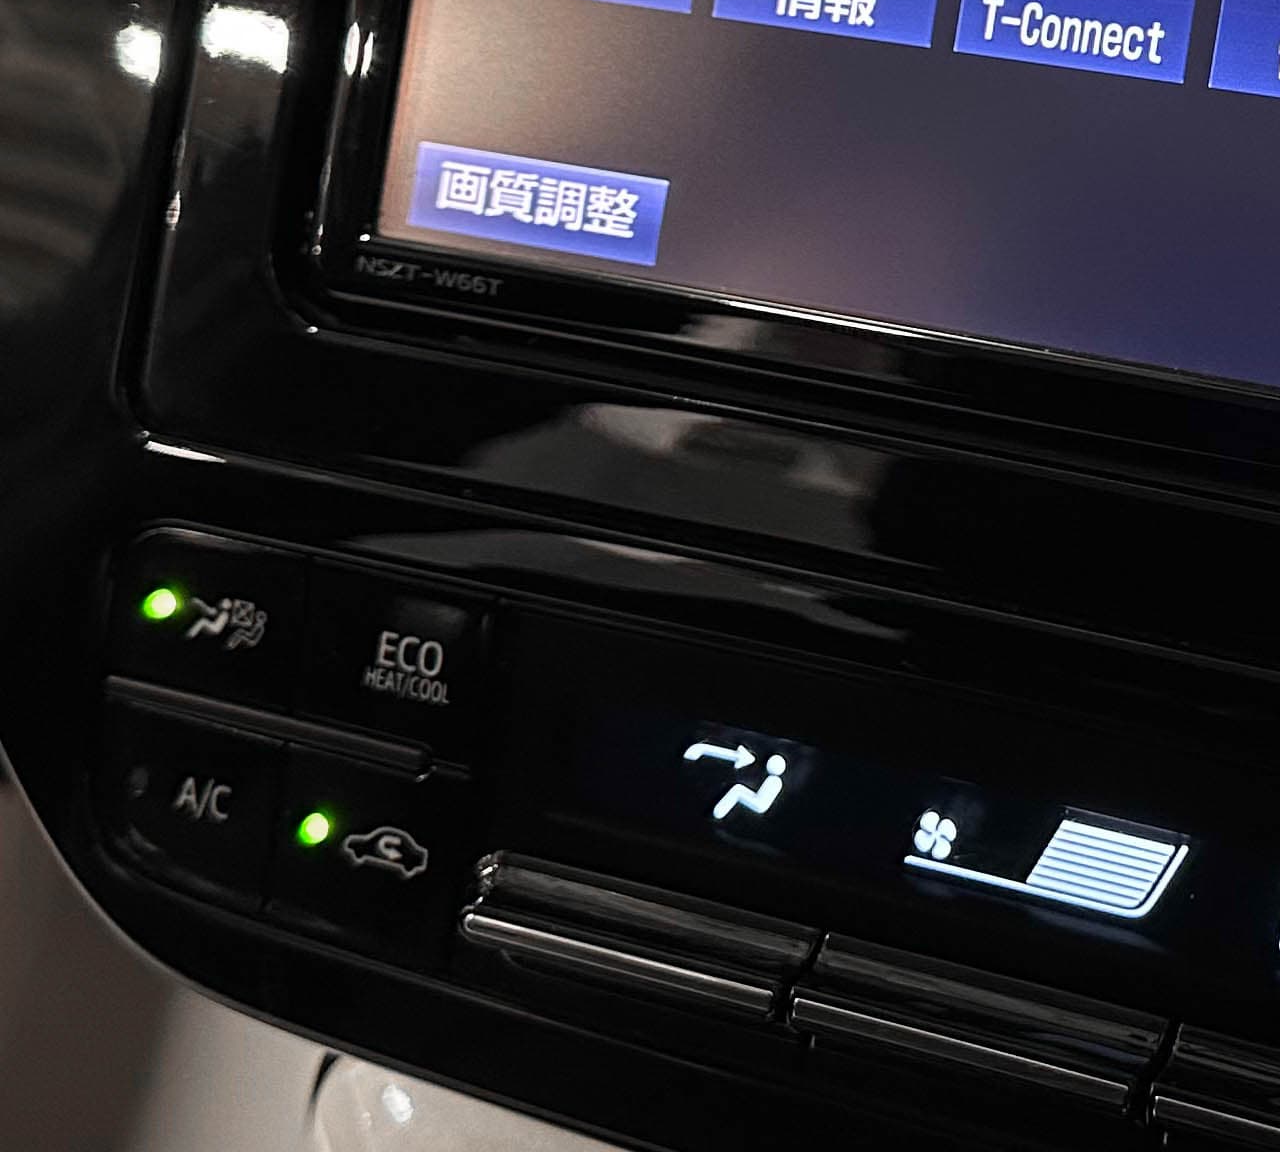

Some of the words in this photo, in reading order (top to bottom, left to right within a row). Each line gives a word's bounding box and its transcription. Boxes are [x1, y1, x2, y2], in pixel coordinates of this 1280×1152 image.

[434, 161, 640, 239] 画質調整
[353, 253, 504, 297] NSZT-W66T
[376, 630, 443, 677] ECO
[362, 665, 451, 705] HEAT/COOL
[175, 776, 232, 822] A/C
